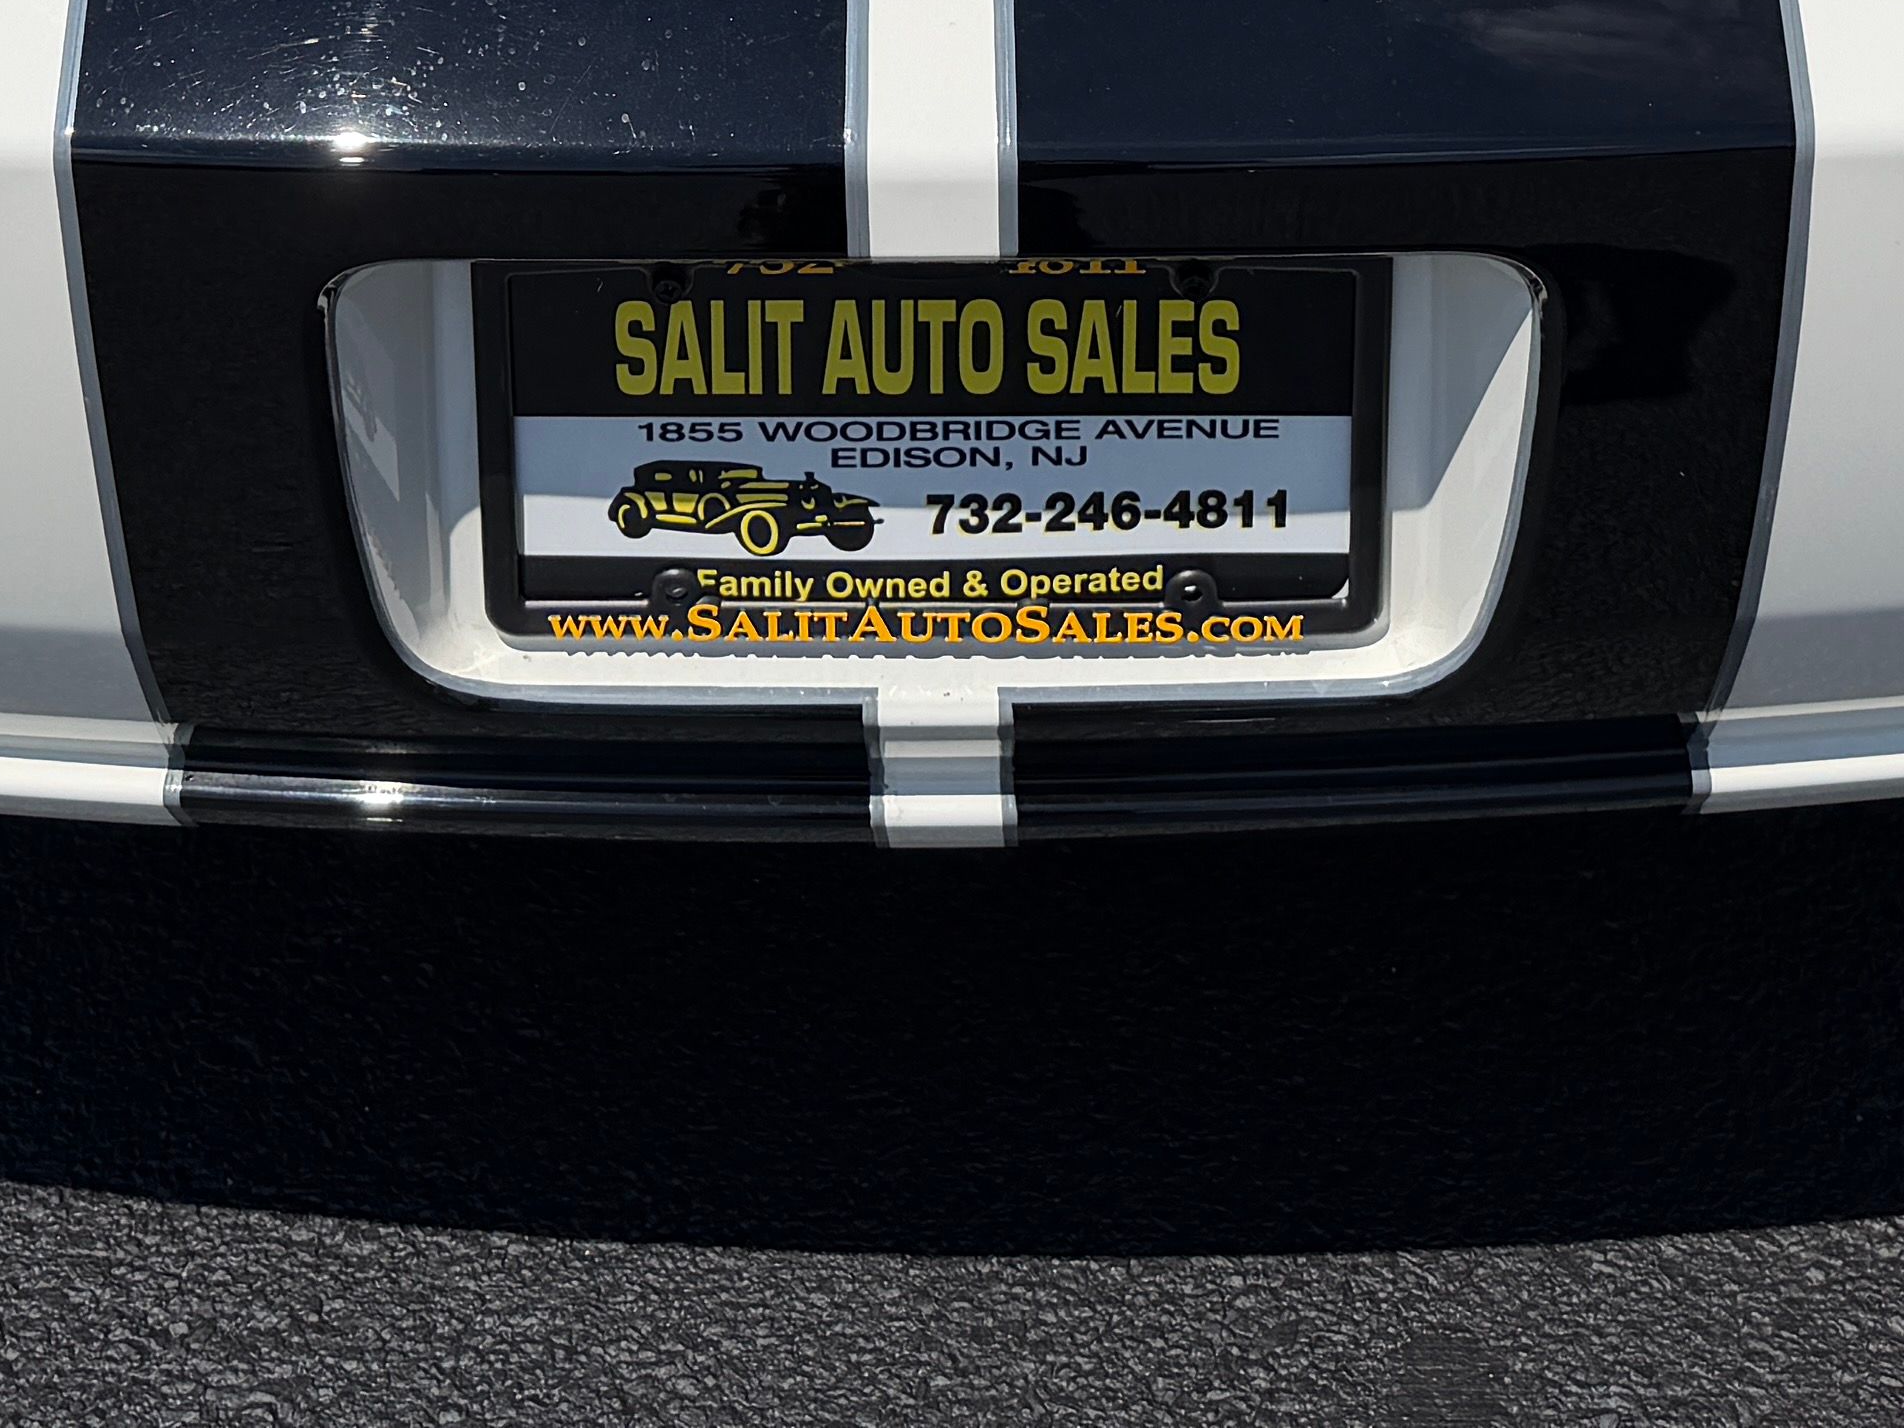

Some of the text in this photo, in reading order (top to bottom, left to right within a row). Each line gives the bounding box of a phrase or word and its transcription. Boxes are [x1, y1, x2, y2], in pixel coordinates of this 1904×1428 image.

[614, 298, 1241, 397] SALIT AUTO SALES
[638, 418, 1280, 443] 1855 WOODBRIDGE AVENUE
[831, 445, 1088, 471] EDISON, NJ
[926, 489, 1288, 535] 732-246-4811
[697, 565, 1163, 601] Family Owned & Operated
